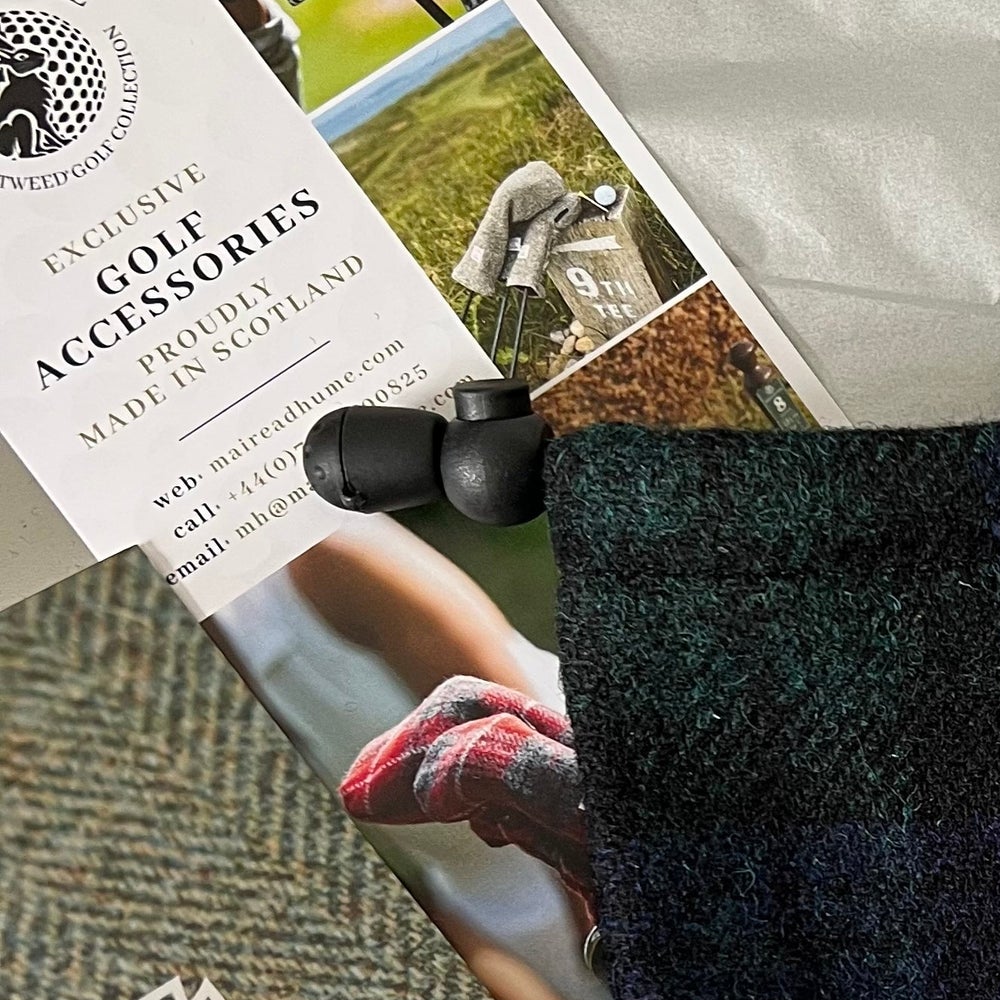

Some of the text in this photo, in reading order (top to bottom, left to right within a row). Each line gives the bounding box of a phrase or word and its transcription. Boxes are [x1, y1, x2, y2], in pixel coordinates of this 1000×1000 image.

[72, 139, 115, 178] GOLF
[102, 25, 139, 141] COLLECTION
[41, 162, 207, 275] EXCLUSIVE
[96, 209, 206, 295] GOLF
[36, 187, 320, 391] ACCESSORIES
[136, 276, 275, 377] PROUDLY
[77, 254, 365, 450] MADE IN SCOTLAND
[208, 337, 406, 475] maireadhume.com
[773, 396, 787, 413] 8
